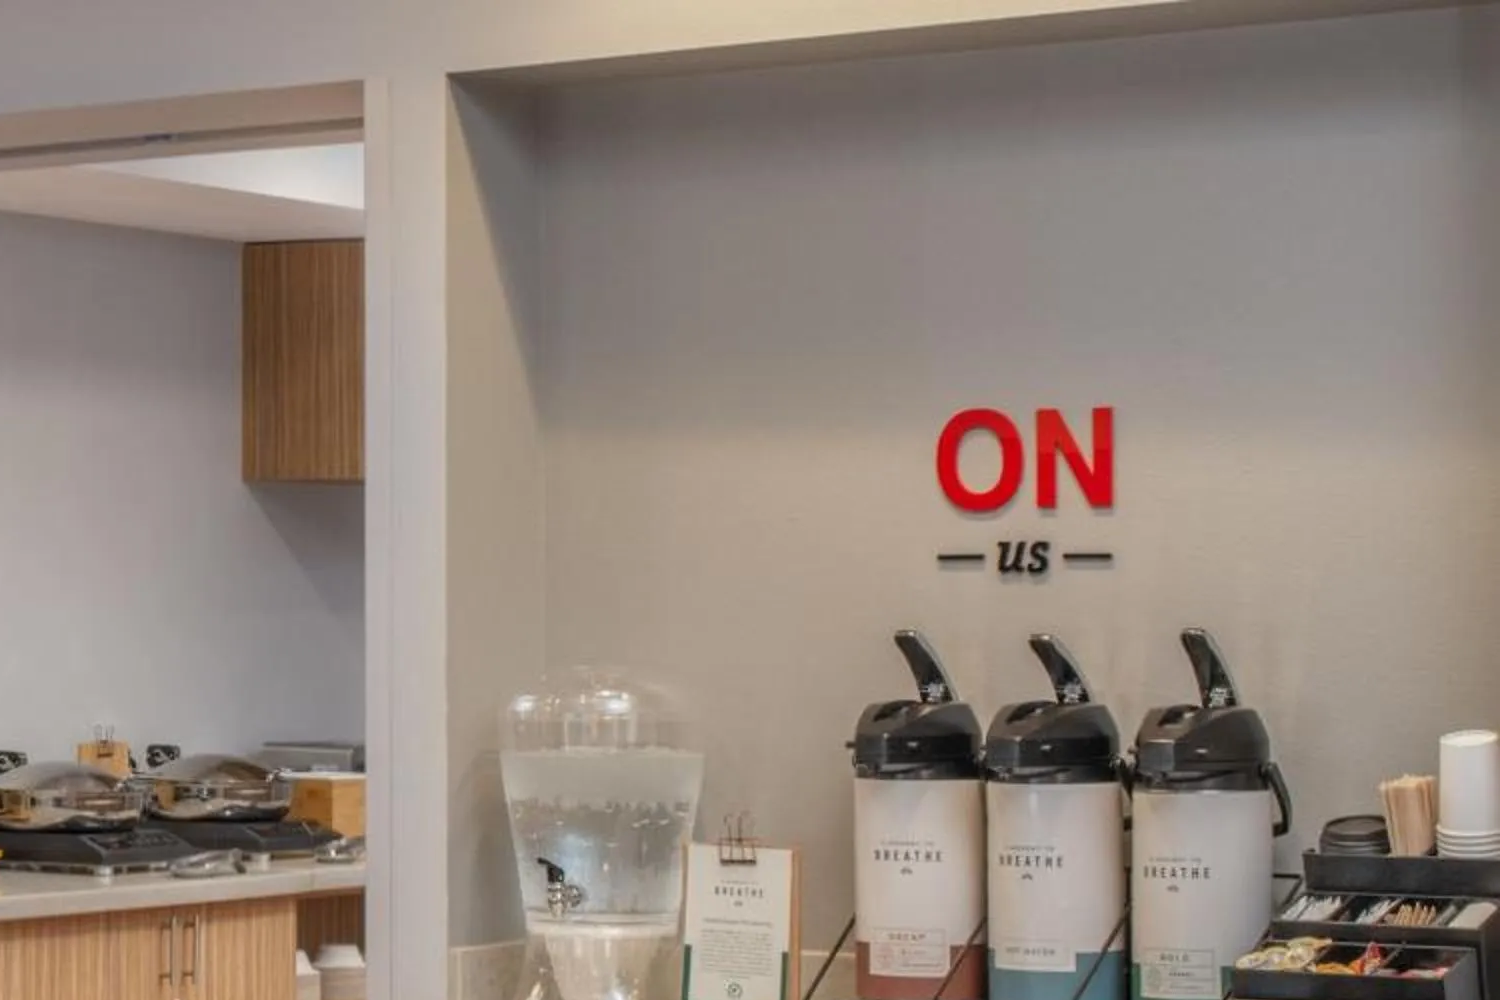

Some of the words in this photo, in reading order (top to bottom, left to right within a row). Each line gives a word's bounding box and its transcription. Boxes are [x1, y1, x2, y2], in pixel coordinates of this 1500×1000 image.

[936, 406, 1114, 513] ON
[997, 540, 1051, 574] us
[874, 849, 941, 862] BREATHE
[998, 854, 1064, 868] BREATHE
[1143, 865, 1211, 880] BREATHE
[714, 886, 764, 898] BREATHE
